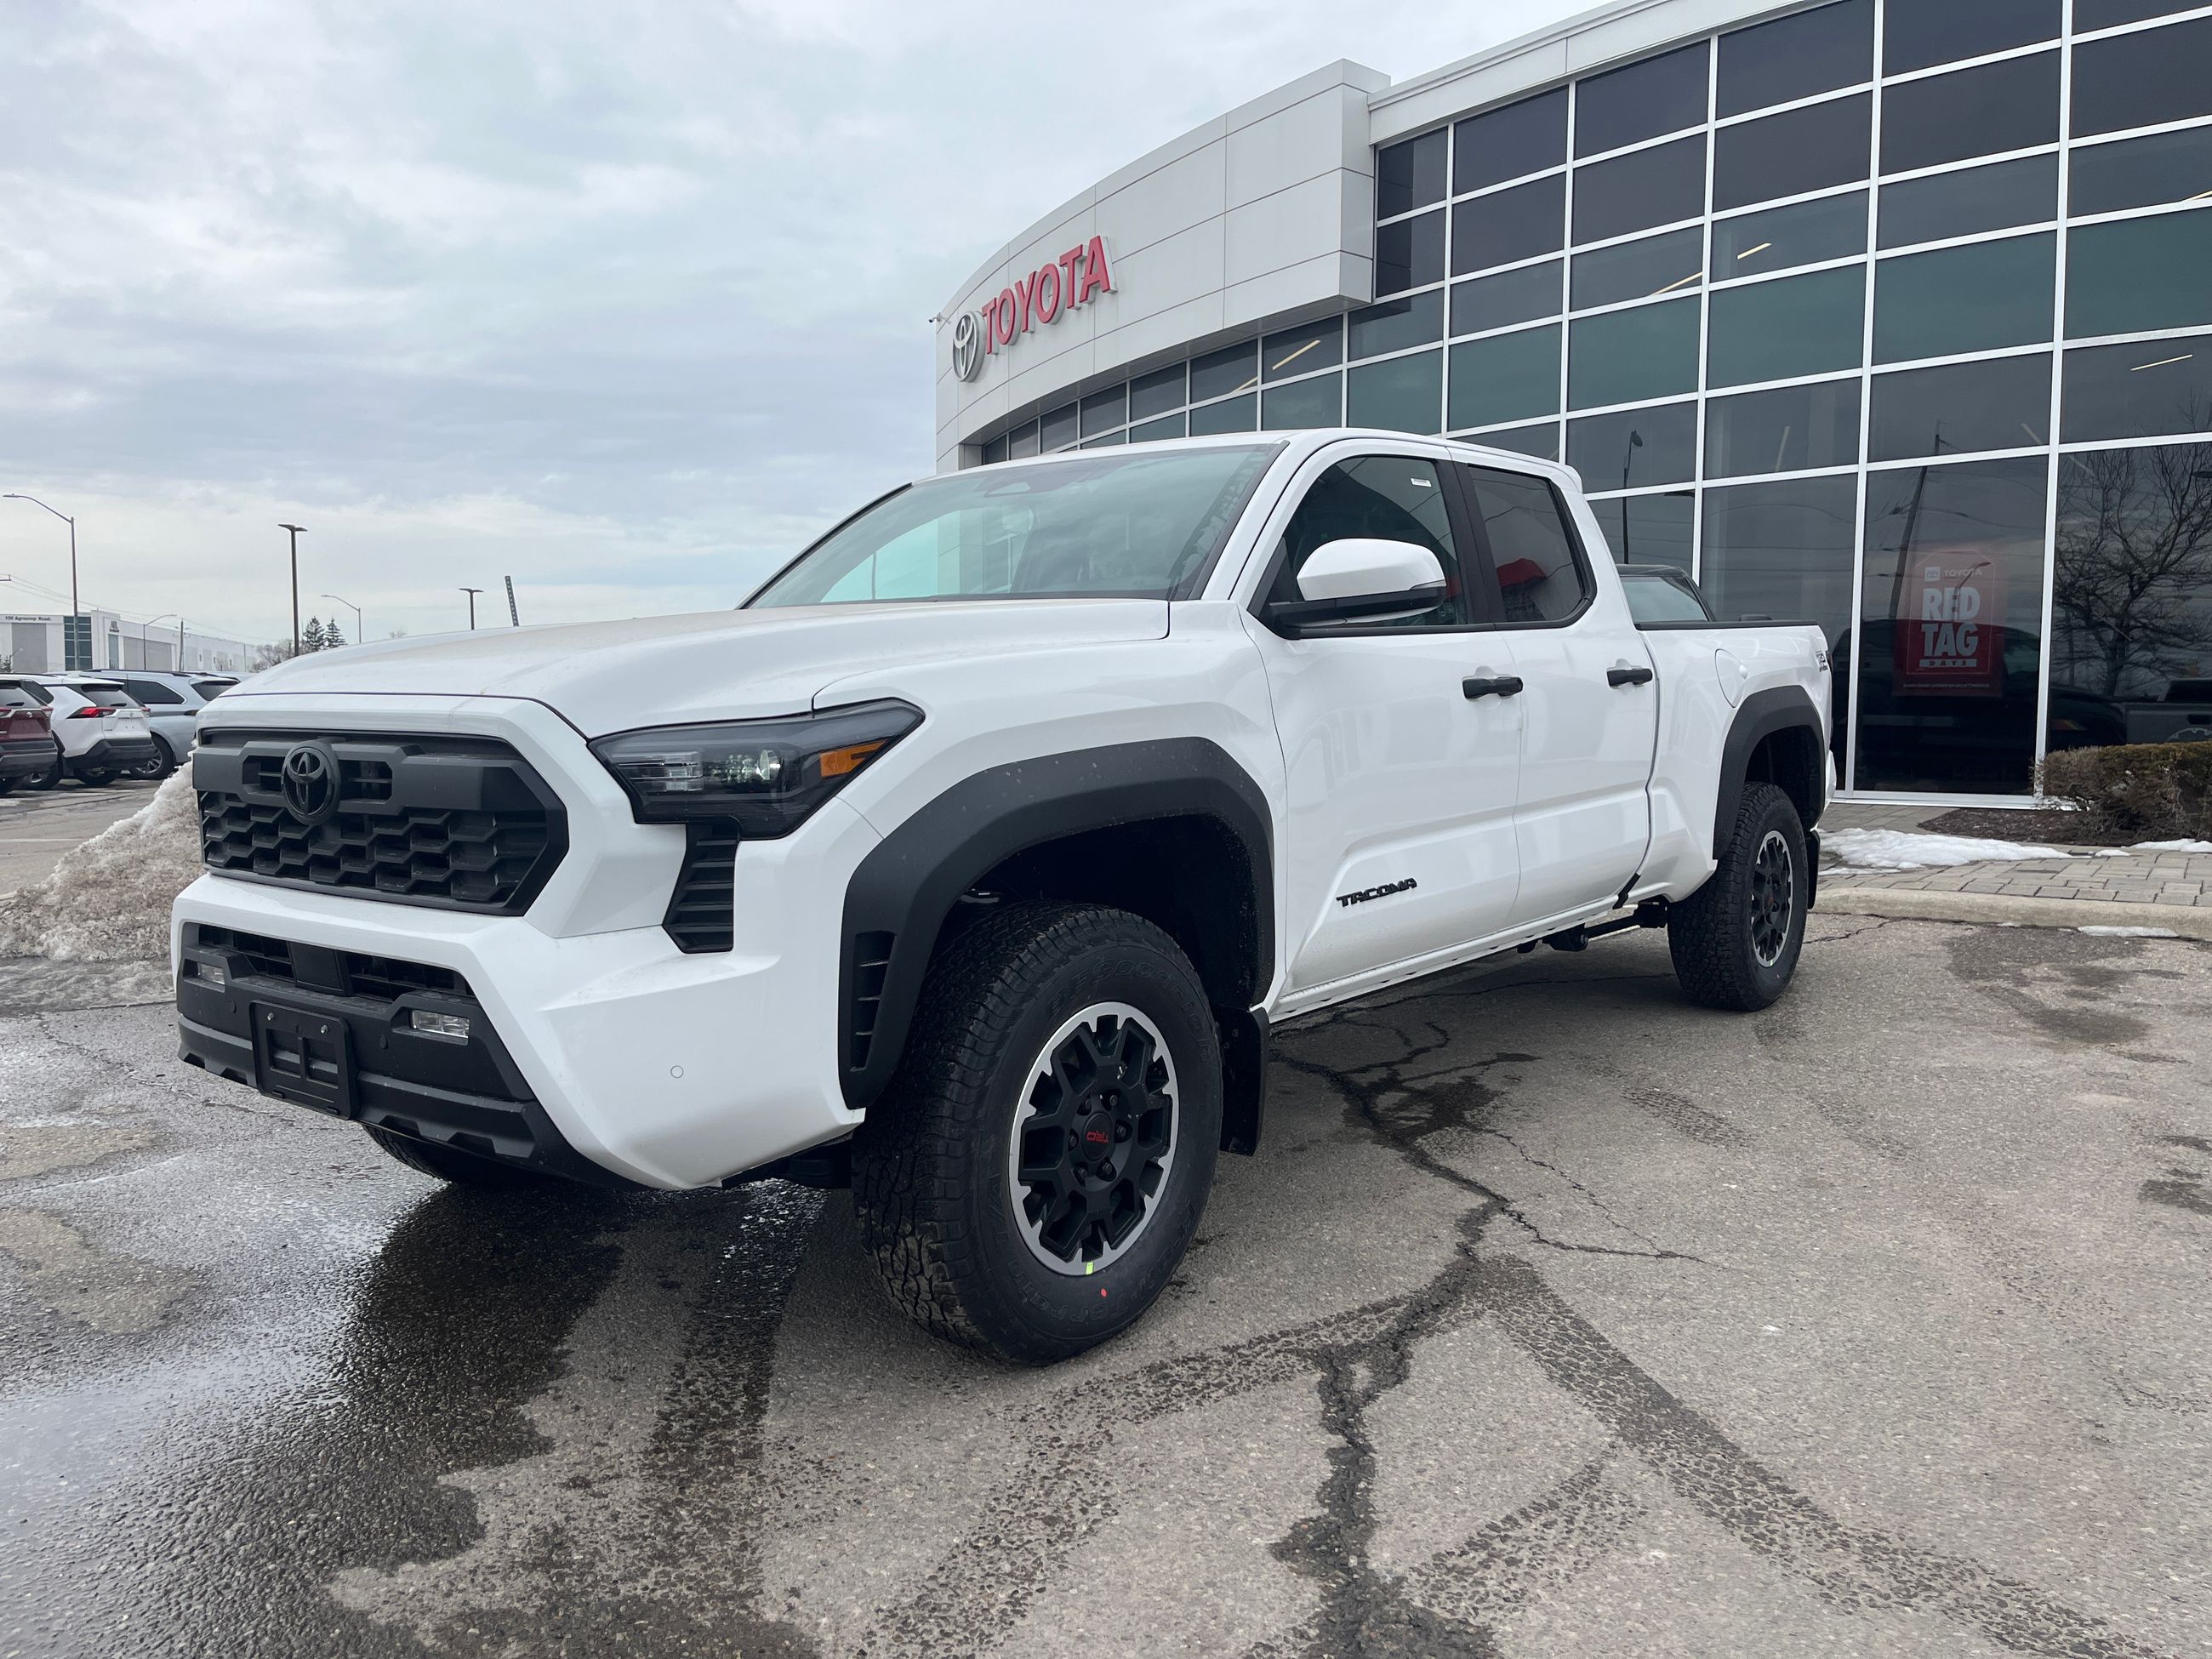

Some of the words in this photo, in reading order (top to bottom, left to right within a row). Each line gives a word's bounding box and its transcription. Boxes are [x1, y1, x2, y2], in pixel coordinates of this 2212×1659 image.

[982, 235, 1115, 355] TOYOTA
[1944, 568, 1983, 578] TOYOTA
[1922, 587, 1981, 620] RED
[1922, 622, 1979, 657] TAG
[1336, 877, 1417, 907] TACOMA
